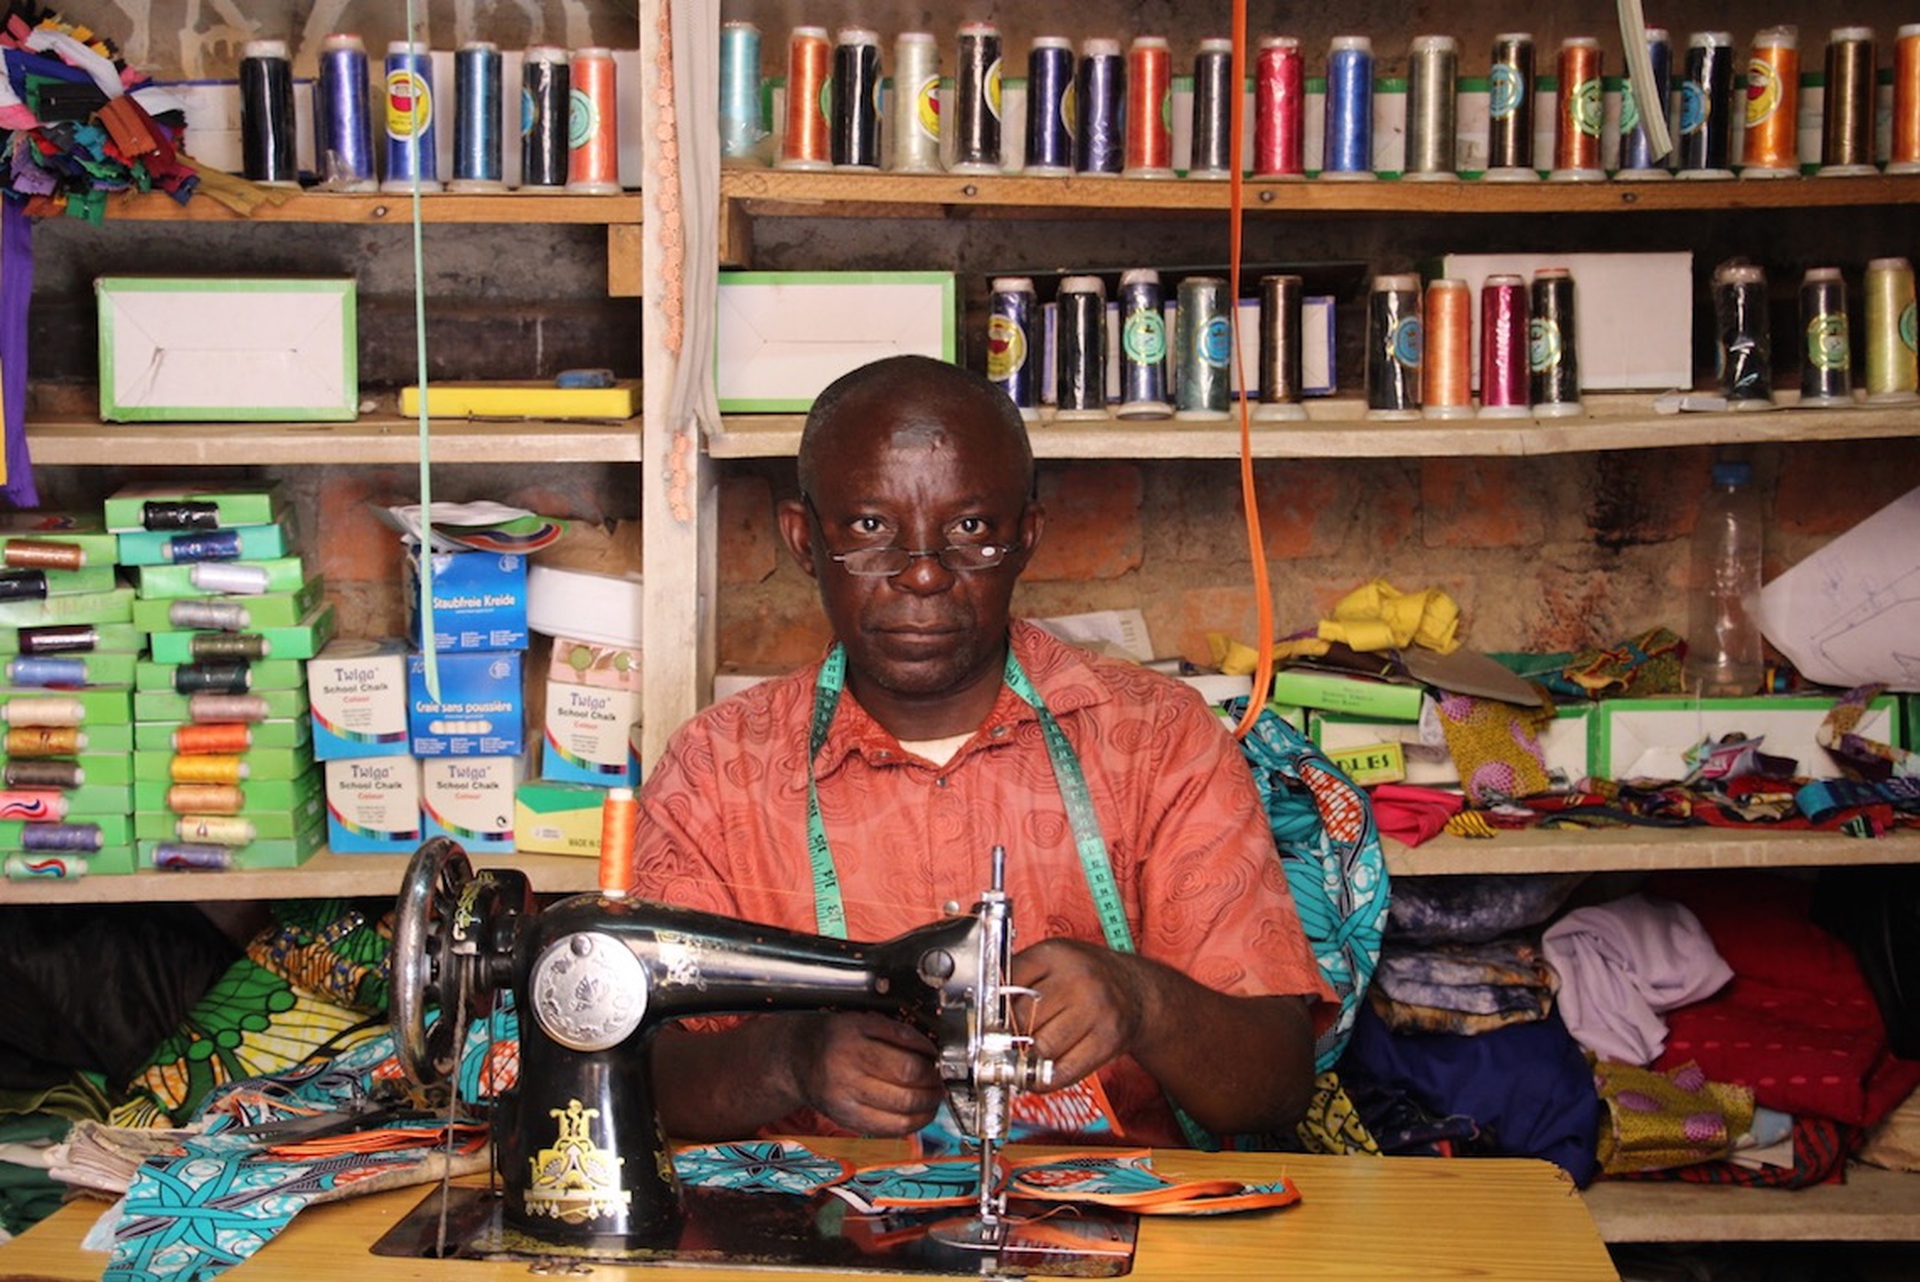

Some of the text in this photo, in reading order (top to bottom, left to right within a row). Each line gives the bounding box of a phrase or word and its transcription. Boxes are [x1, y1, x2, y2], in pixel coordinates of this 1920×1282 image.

[483, 593, 516, 607] Kreide
[335, 668, 375, 683] Twiga
[323, 683, 388, 695] School Chalk
[570, 692, 606, 709] Twiga
[441, 703, 464, 713] sans
[558, 707, 616, 721] School Chalk
[350, 765, 390, 780] Twiga
[448, 765, 486, 780] Twiga
[339, 781, 403, 790] School Chalk
[437, 781, 500, 790] School Chalk
[568, 838, 587, 848] MADE
[814, 833, 828, 853] 15
[823, 869, 837, 889] 14
[826, 904, 842, 923] 13
